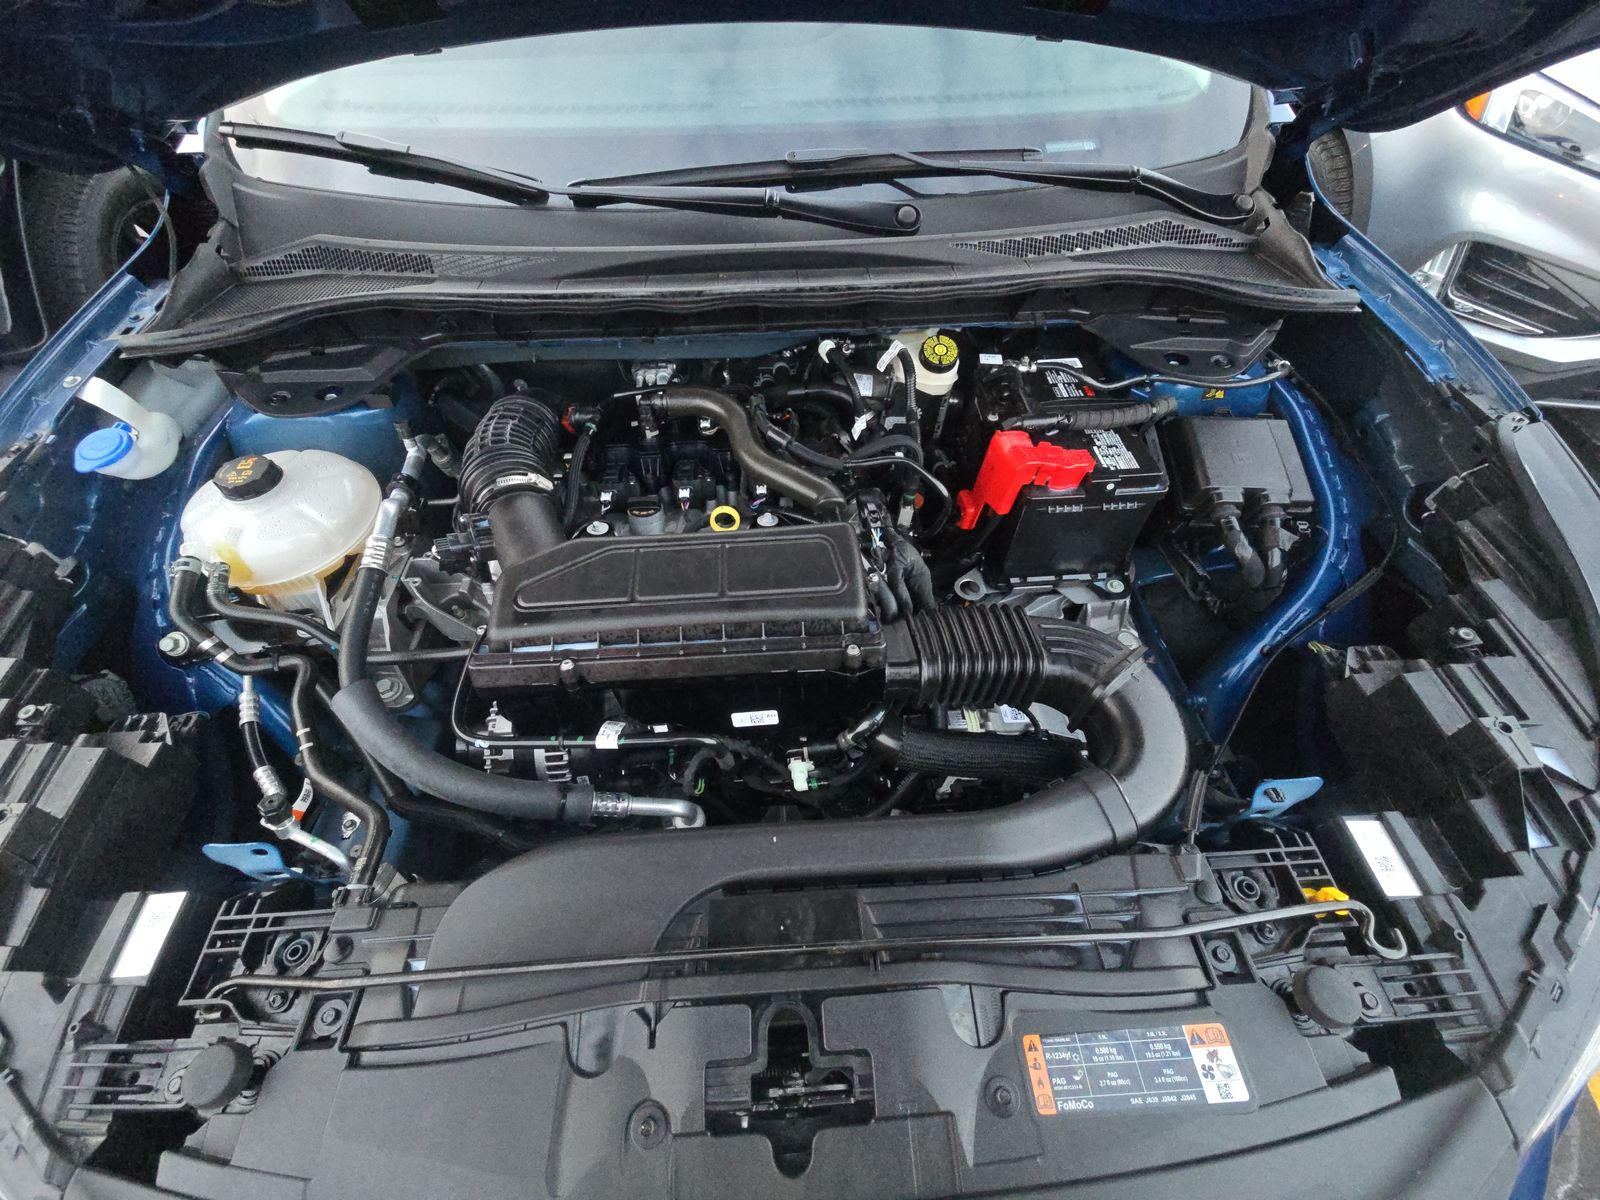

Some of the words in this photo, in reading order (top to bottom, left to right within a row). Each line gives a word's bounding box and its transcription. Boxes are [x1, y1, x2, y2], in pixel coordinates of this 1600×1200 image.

[1045, 1051, 1071, 1061] R-1234yf
[1052, 1077, 1067, 1086] PAG
[1057, 1099, 1094, 1110] FoMoCo
